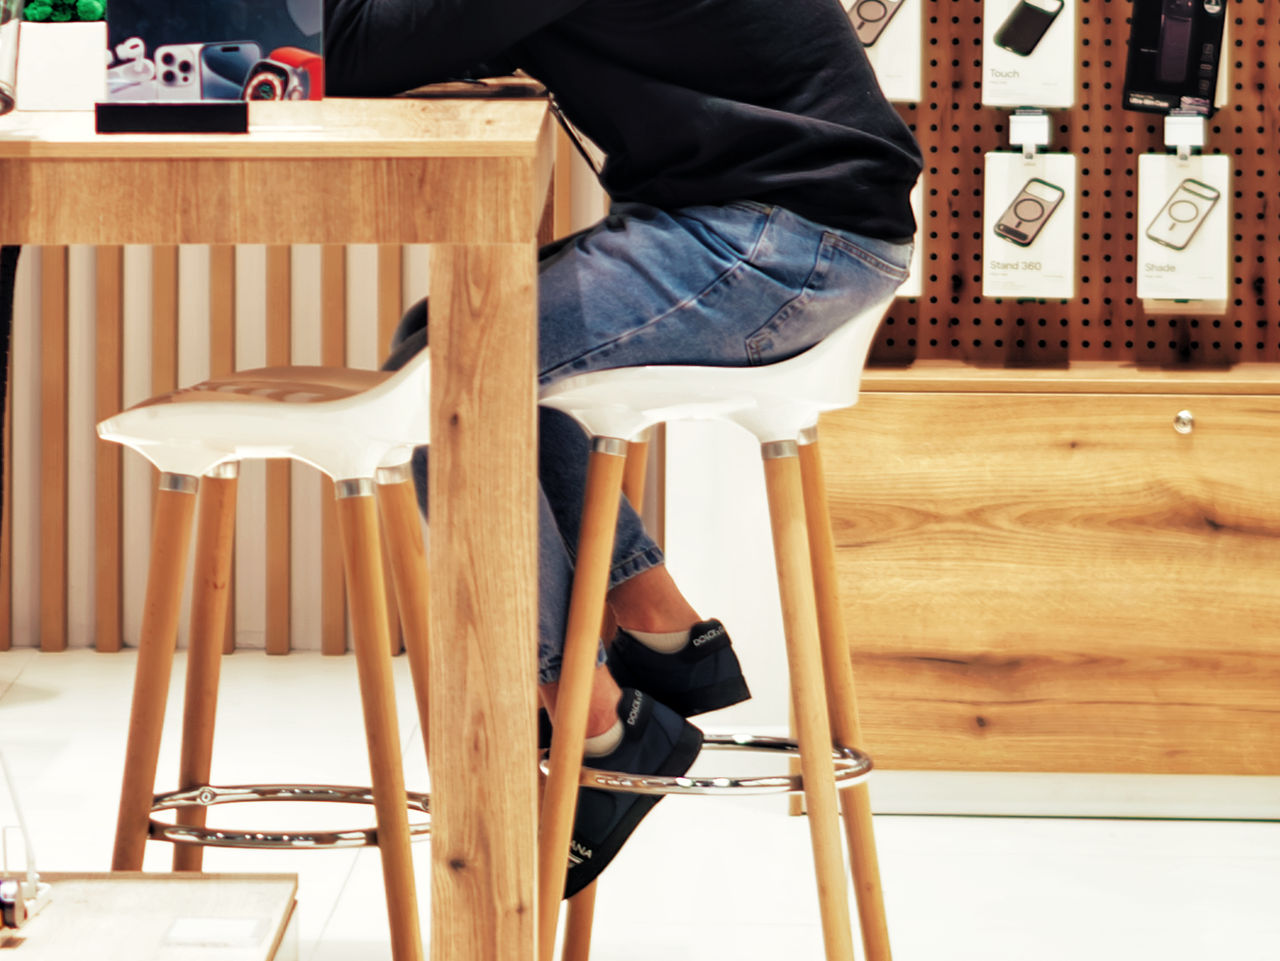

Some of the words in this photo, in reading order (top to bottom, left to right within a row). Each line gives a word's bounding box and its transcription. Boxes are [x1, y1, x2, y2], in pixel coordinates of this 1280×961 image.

[989, 68, 1020, 79] Touch
[990, 259, 1018, 271] Stand
[1020, 259, 1042, 271] 360
[1144, 261, 1176, 273] Shade
